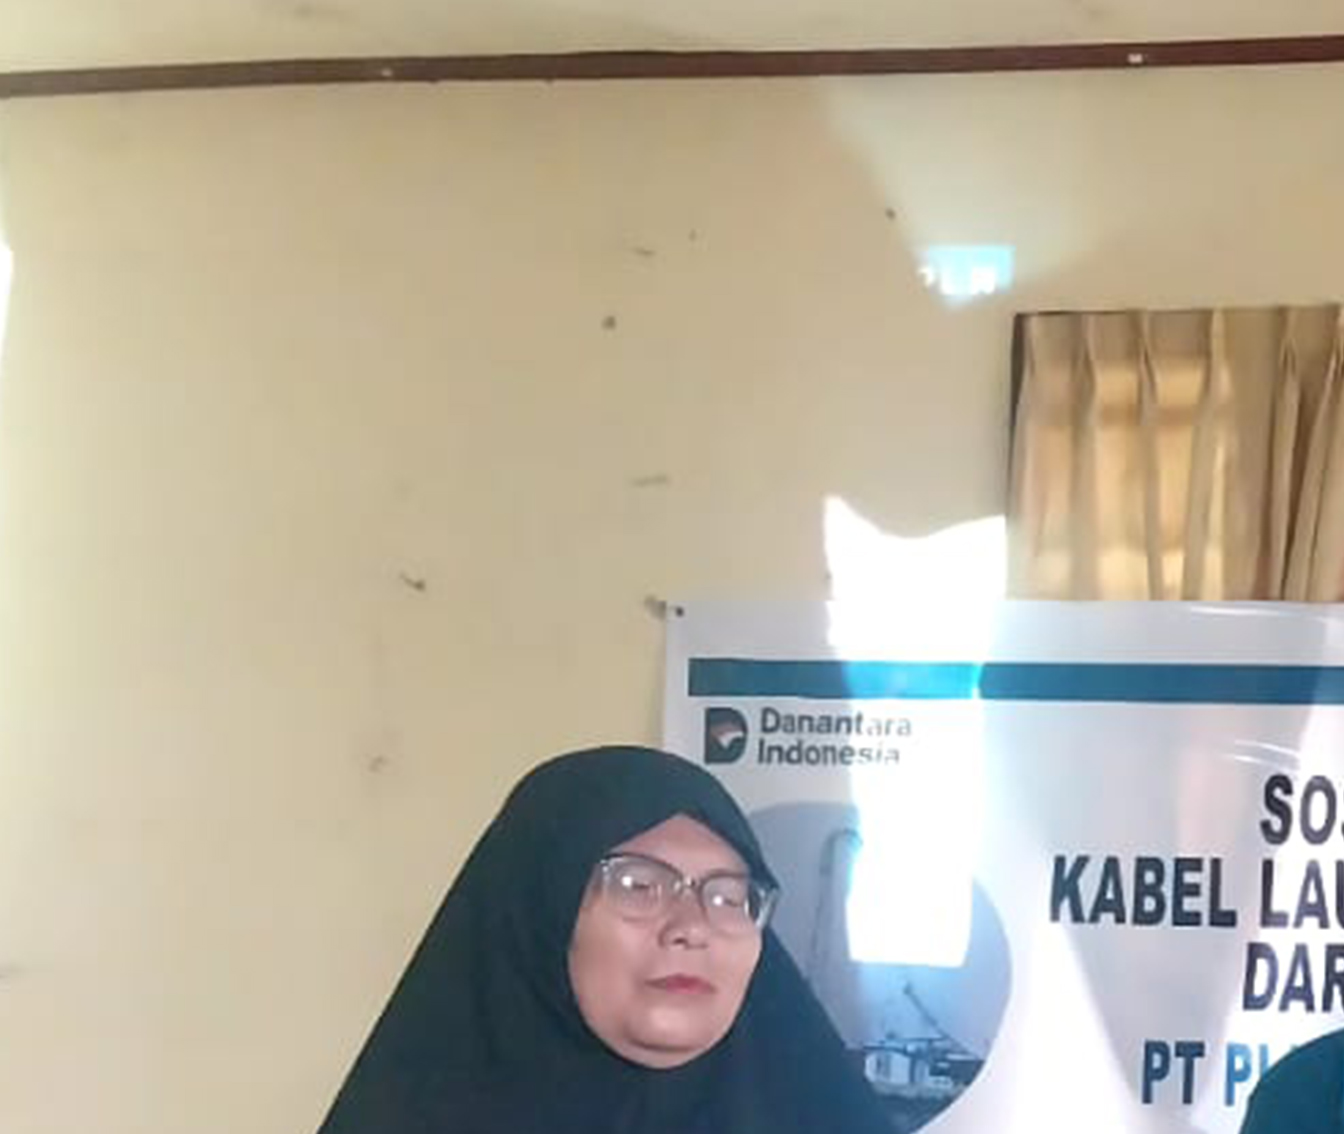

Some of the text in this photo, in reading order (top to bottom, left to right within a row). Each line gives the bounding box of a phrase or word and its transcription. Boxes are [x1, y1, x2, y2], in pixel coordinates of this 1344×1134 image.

[760, 707, 911, 737] Danantara
[757, 740, 900, 766] Indonesia
[1049, 855, 1237, 927] KABEL
[1142, 1041, 1205, 1104] PT
